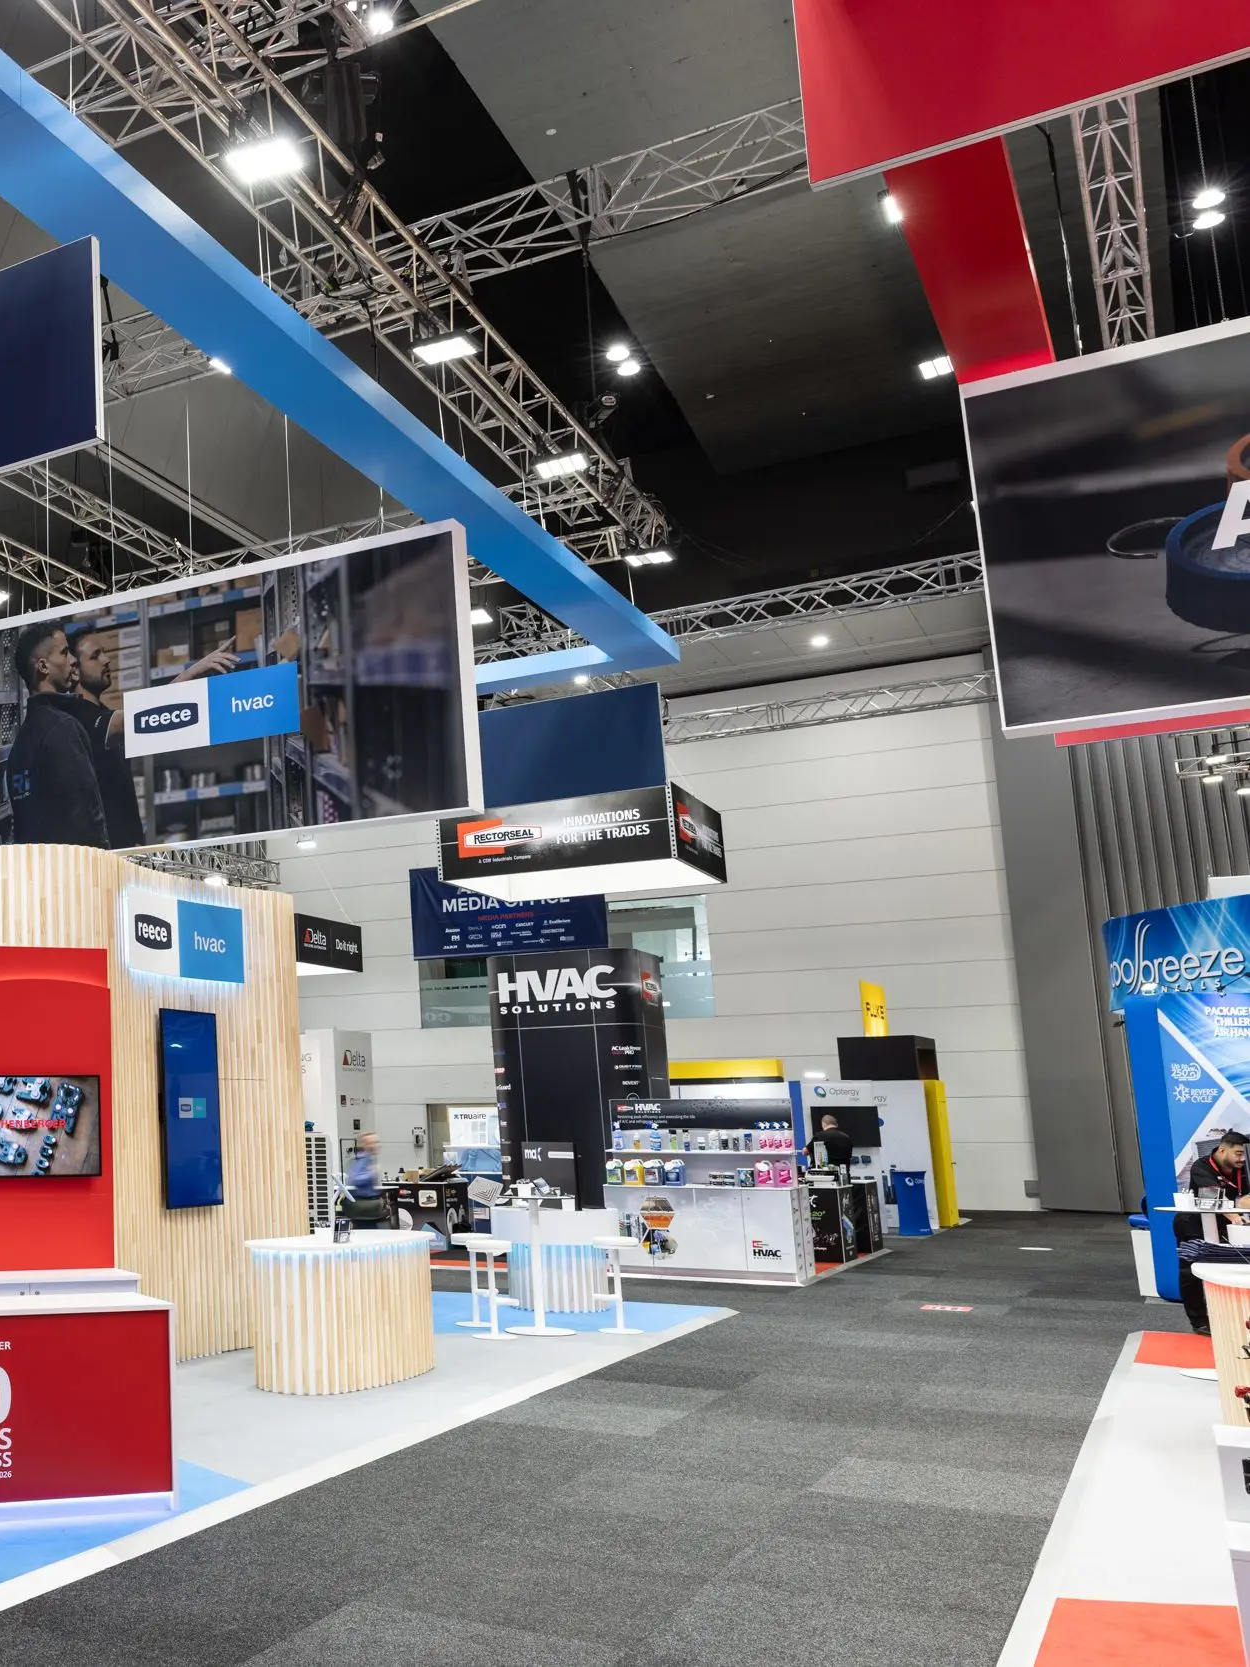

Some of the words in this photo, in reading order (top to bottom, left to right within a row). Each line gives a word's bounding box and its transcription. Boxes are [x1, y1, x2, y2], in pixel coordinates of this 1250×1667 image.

[140, 705, 191, 728] reece
[231, 690, 274, 713] hvac
[562, 808, 641, 828] INNOVATIONS
[473, 827, 535, 845] RECTORSEAL
[556, 831, 584, 845] FOR
[584, 828, 603, 842] THE
[606, 823, 650, 840] TRADES
[442, 895, 500, 913] MEDIA
[138, 919, 169, 942] reece
[193, 930, 227, 953] hvac
[305, 927, 327, 946] Delta
[497, 965, 618, 1003] HVAC
[500, 1000, 616, 1015] SOLUTIONS
[344, 1050, 366, 1067] Delta
[1171, 1069, 1188, 1077] 250
[829, 1087, 860, 1096] Optergy
[1190, 1088, 1219, 1096] REVERSE
[1191, 1095, 1213, 1103] CYCLE
[634, 1103, 662, 1111] HVAC
[459, 1112, 487, 1120] TRUaire
[753, 1249, 782, 1258] HVAC
